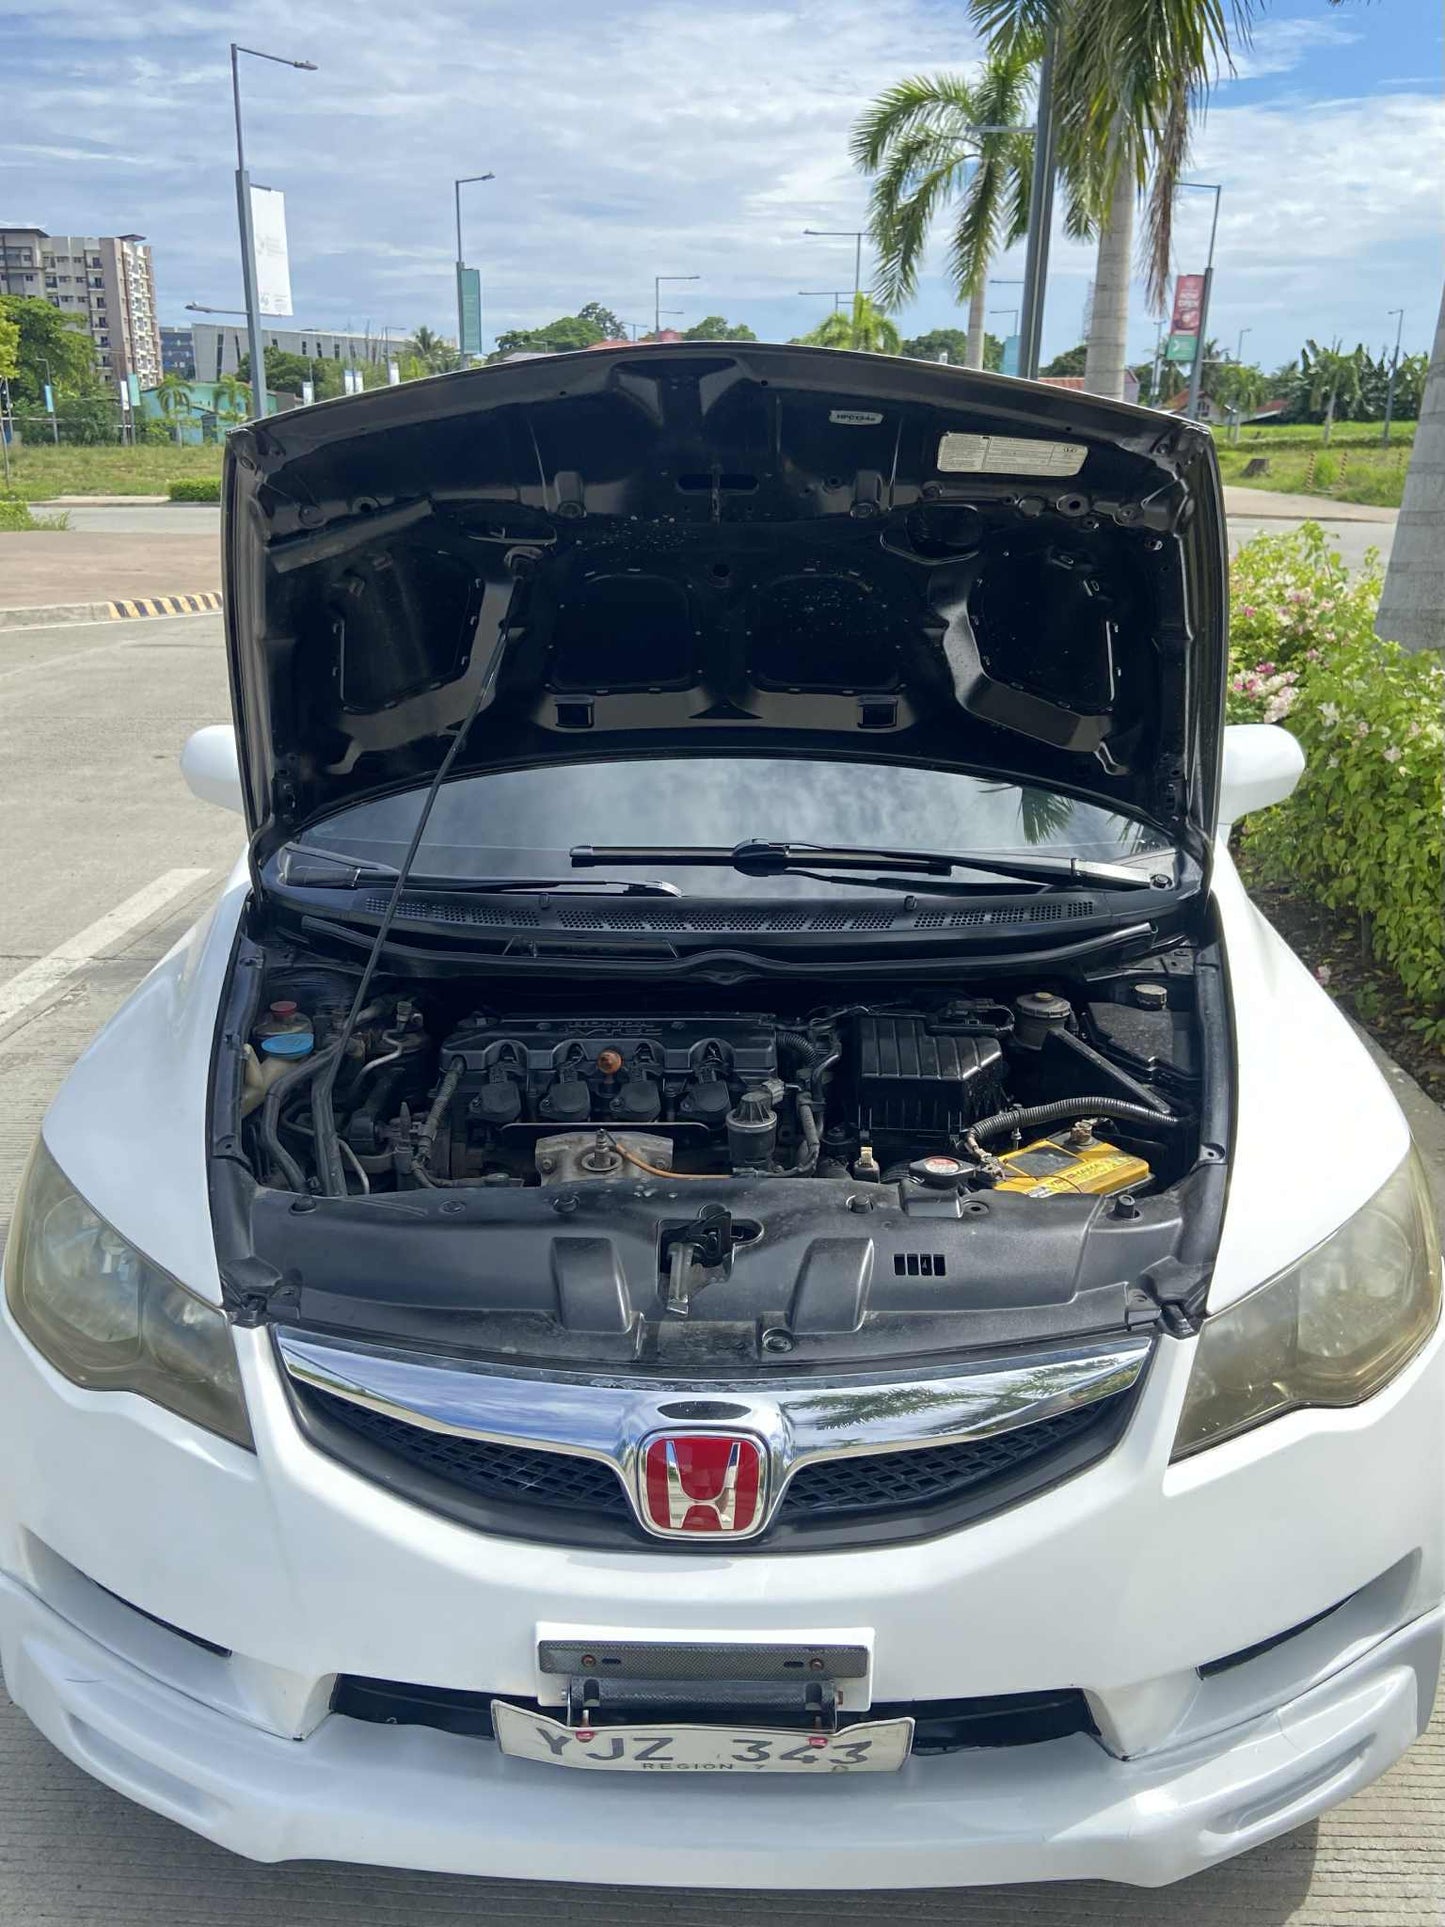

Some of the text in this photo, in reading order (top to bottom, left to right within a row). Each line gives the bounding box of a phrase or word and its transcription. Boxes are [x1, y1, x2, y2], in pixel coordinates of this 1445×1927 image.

[536, 1727, 873, 1766] YJZ 343
[642, 1761, 733, 1770] REGION
